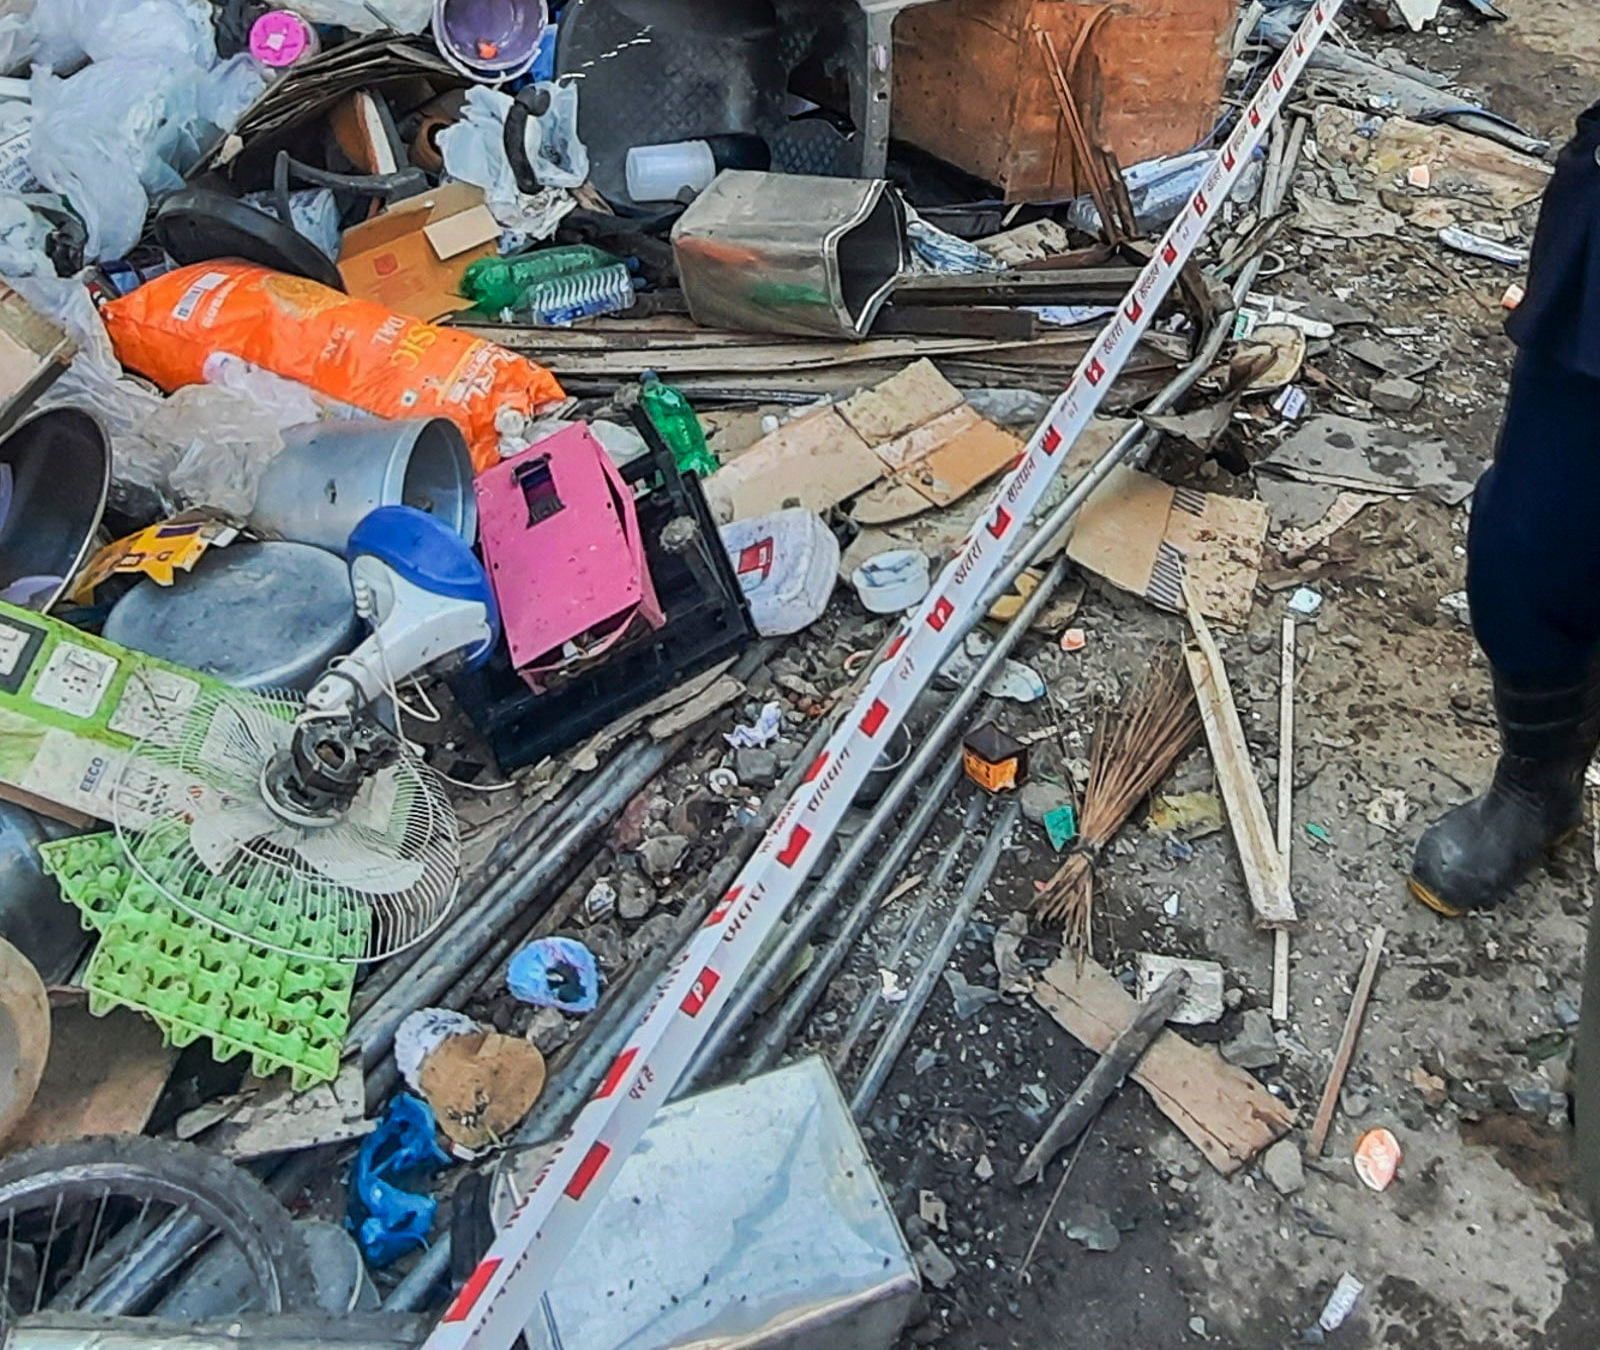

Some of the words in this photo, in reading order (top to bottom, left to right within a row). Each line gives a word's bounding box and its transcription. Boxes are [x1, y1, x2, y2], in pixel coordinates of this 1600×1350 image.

[1005, 456, 1037, 504] सावधान
[954, 539, 983, 585] खतरा
[79, 756, 104, 793] EECO
